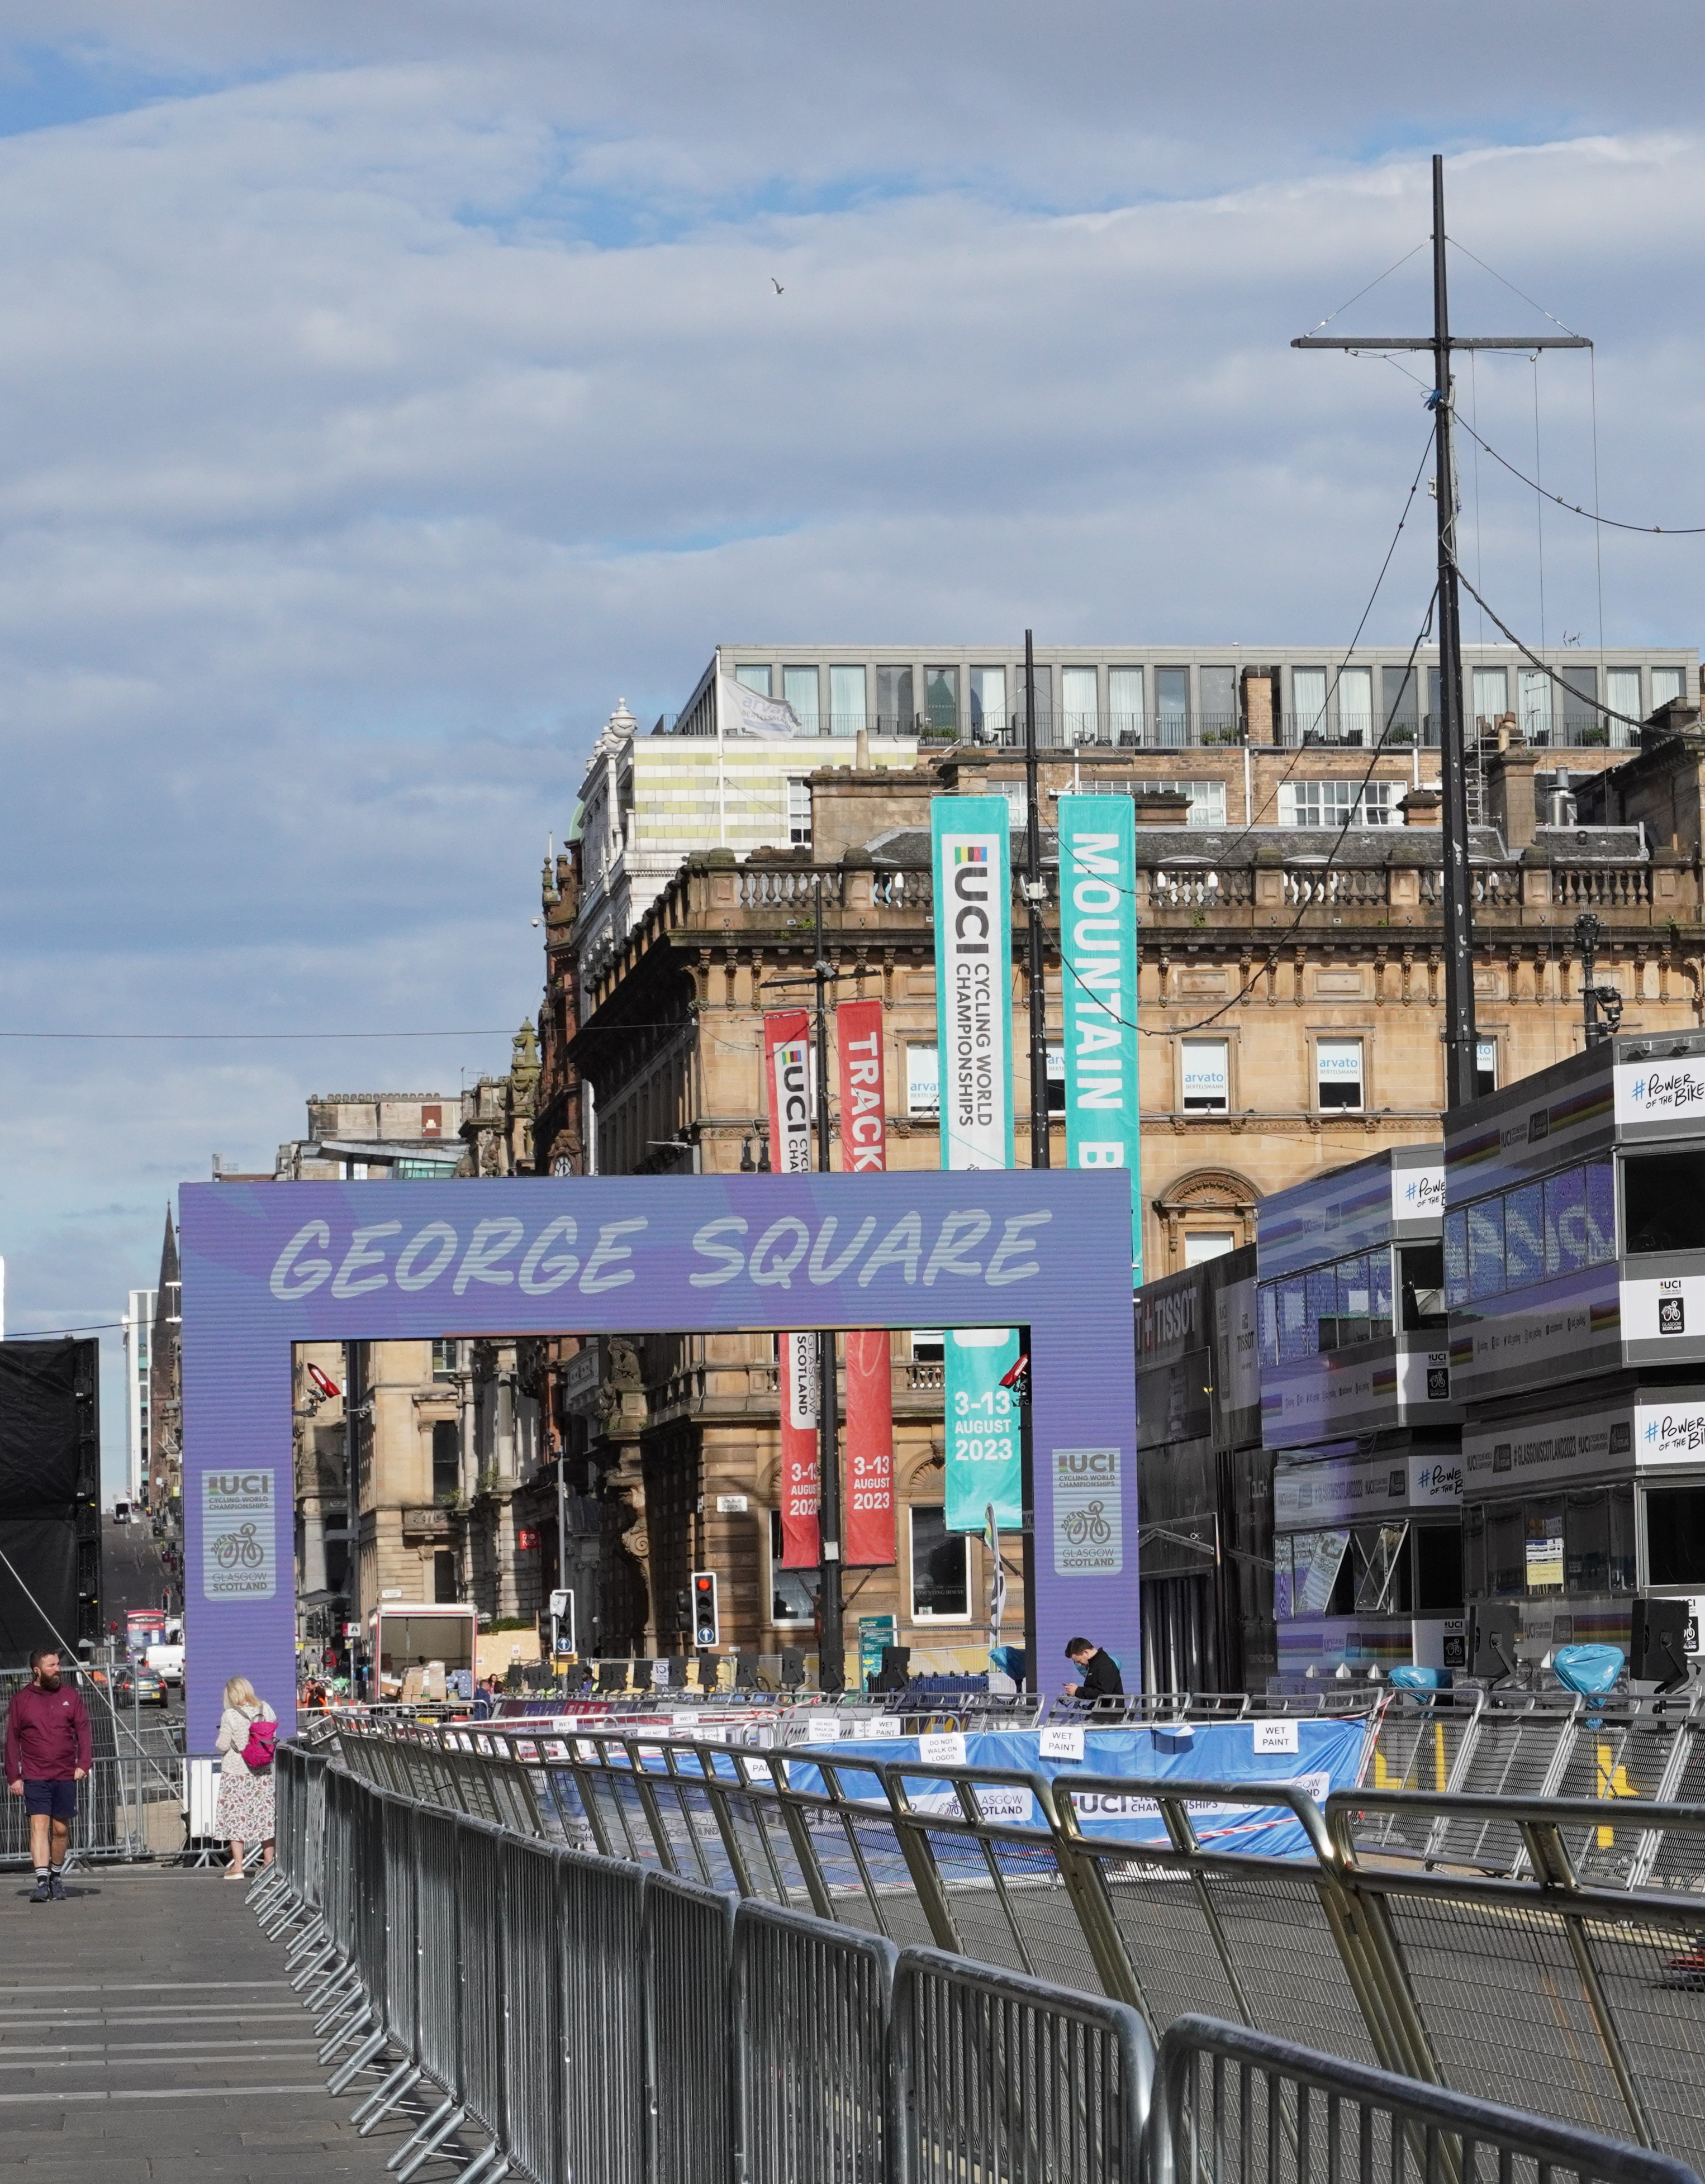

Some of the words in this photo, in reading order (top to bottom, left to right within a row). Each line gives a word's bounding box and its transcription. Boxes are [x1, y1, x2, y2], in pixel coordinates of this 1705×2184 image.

[954, 866, 989, 954] UCI
[1072, 833, 1124, 1110] MOUNTAIN
[974, 963, 991, 1048] CYCLING
[956, 963, 973, 1126] CHAMPIONSHIPS
[1319, 1058, 1358, 1068] arvato
[1185, 1072, 1224, 1083] arvato
[783, 1065, 806, 1133] UCI
[976, 1053, 992, 1127] WORLD
[848, 1032, 882, 1171] TRACK
[1645, 1100, 1656, 1109] OF
[1658, 1094, 1673, 1105] THE
[1429, 1196, 1440, 1205] THE
[269, 1215, 649, 1300] GEORGE
[689, 1208, 1053, 1290] SQUARE
[1664, 1280, 1682, 1289] UCI
[1155, 1287, 1197, 1343] TISSOT
[1237, 1331, 1255, 1353] TISSOT
[796, 1335, 808, 1416] SCOTLAND
[954, 1390, 1011, 1415] 3-13
[954, 1419, 1012, 1434] AUGUST
[955, 1439, 1013, 1461] 2023
[1659, 1442, 1671, 1452] OF
[1672, 1437, 1686, 1448] THE
[853, 1455, 890, 1475] 3-13
[1069, 1454, 1115, 1473] UCI
[220, 1475, 269, 1495] UCI
[853, 1477, 890, 1490] AUGUST
[1429, 1486, 1441, 1496] OF
[1440, 1484, 1454, 1493] THE
[853, 1492, 890, 1510] 2023
[1061, 1511, 1077, 1531] 2023
[211, 1534, 228, 1555] 2023
[1062, 1548, 1114, 1558] GLASGOW
[1062, 1558, 1114, 1567] SCOTLAND
[212, 1572, 267, 1582] GLASGOW
[212, 1582, 267, 1591] SCOTLAND
[1052, 1731, 1073, 1740] WET
[1048, 1742, 1076, 1752] PAINT
[1080, 1795, 1126, 1814] UCI
